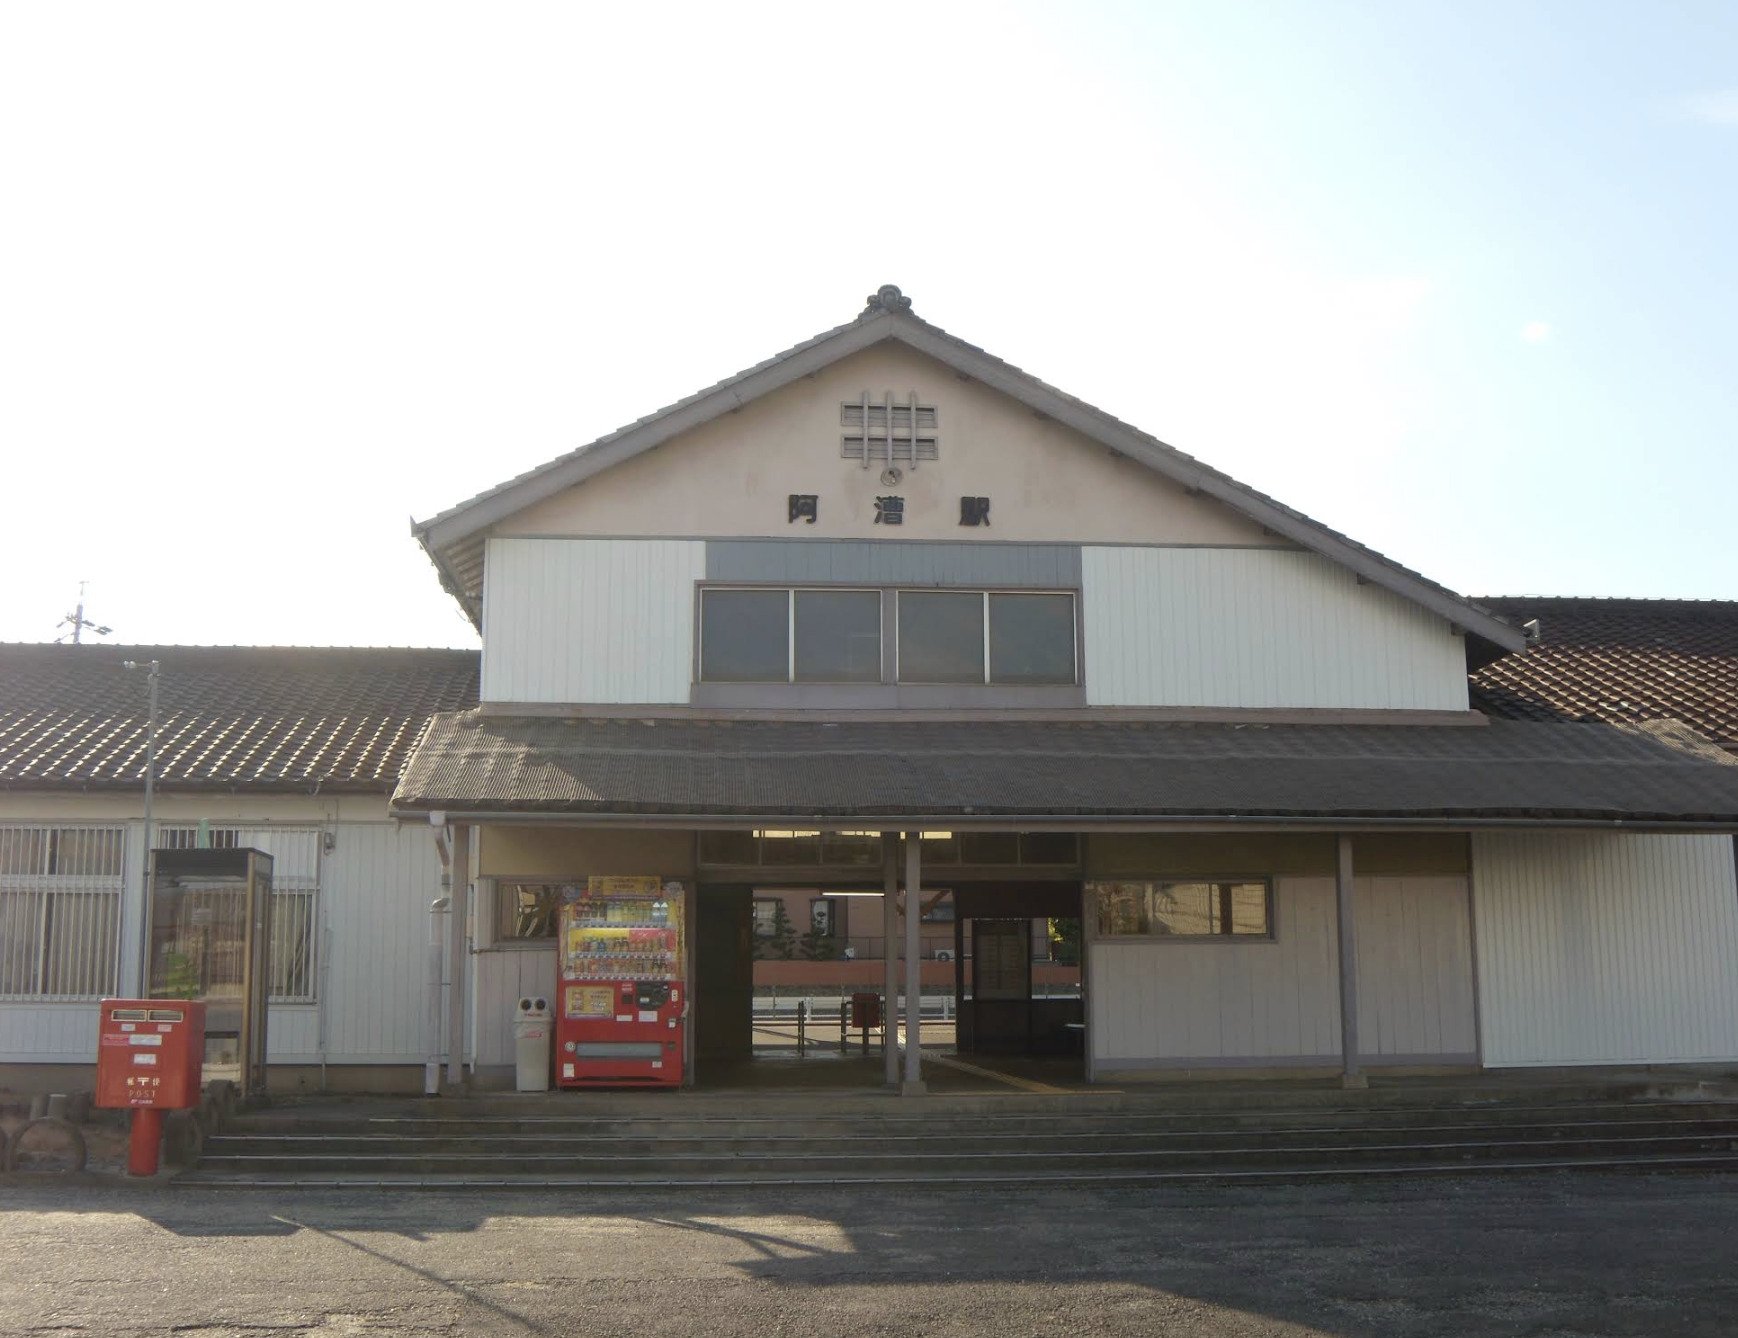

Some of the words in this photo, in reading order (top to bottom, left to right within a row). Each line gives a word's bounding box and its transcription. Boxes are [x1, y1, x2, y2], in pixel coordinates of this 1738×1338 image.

[788, 494, 991, 527] 阿漕駅
[129, 1090, 155, 1098] POST
